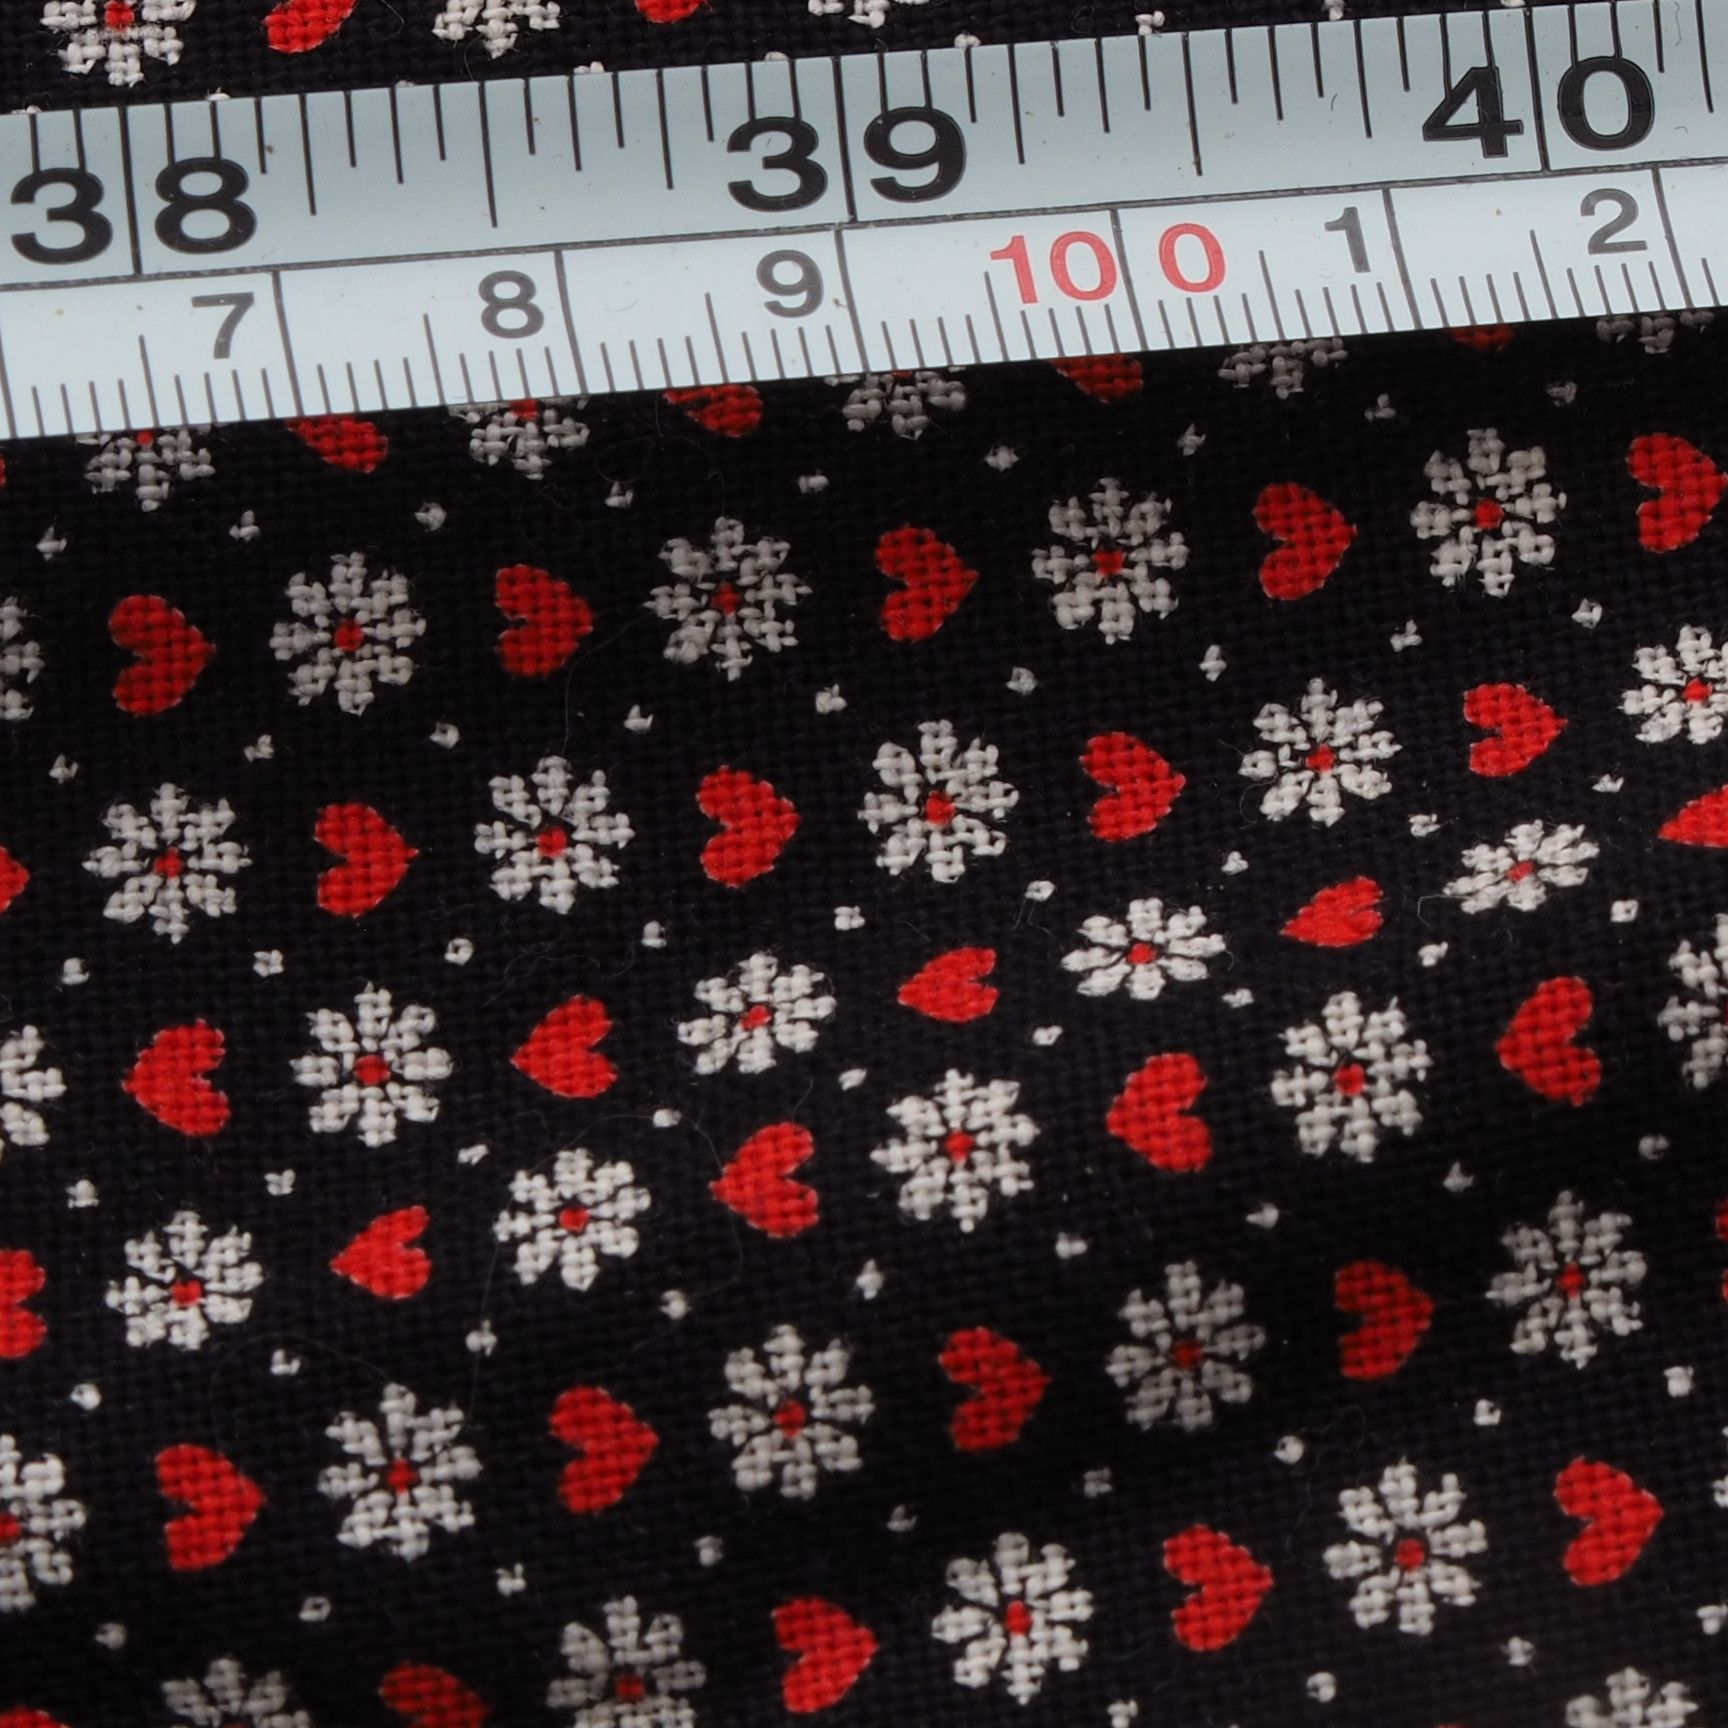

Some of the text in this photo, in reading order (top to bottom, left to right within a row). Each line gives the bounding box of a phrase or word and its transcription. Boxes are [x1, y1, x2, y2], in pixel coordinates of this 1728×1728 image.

[11, 157, 257, 264] 38
[727, 106, 967, 212] 39
[1422, 55, 1655, 159] 40
[191, 291, 255, 360] 7
[477, 270, 545, 339] 8
[755, 248, 825, 319] 9
[989, 222, 1227, 306] 100
[1323, 205, 1371, 273] 1
[1579, 188, 1648, 255] 2
